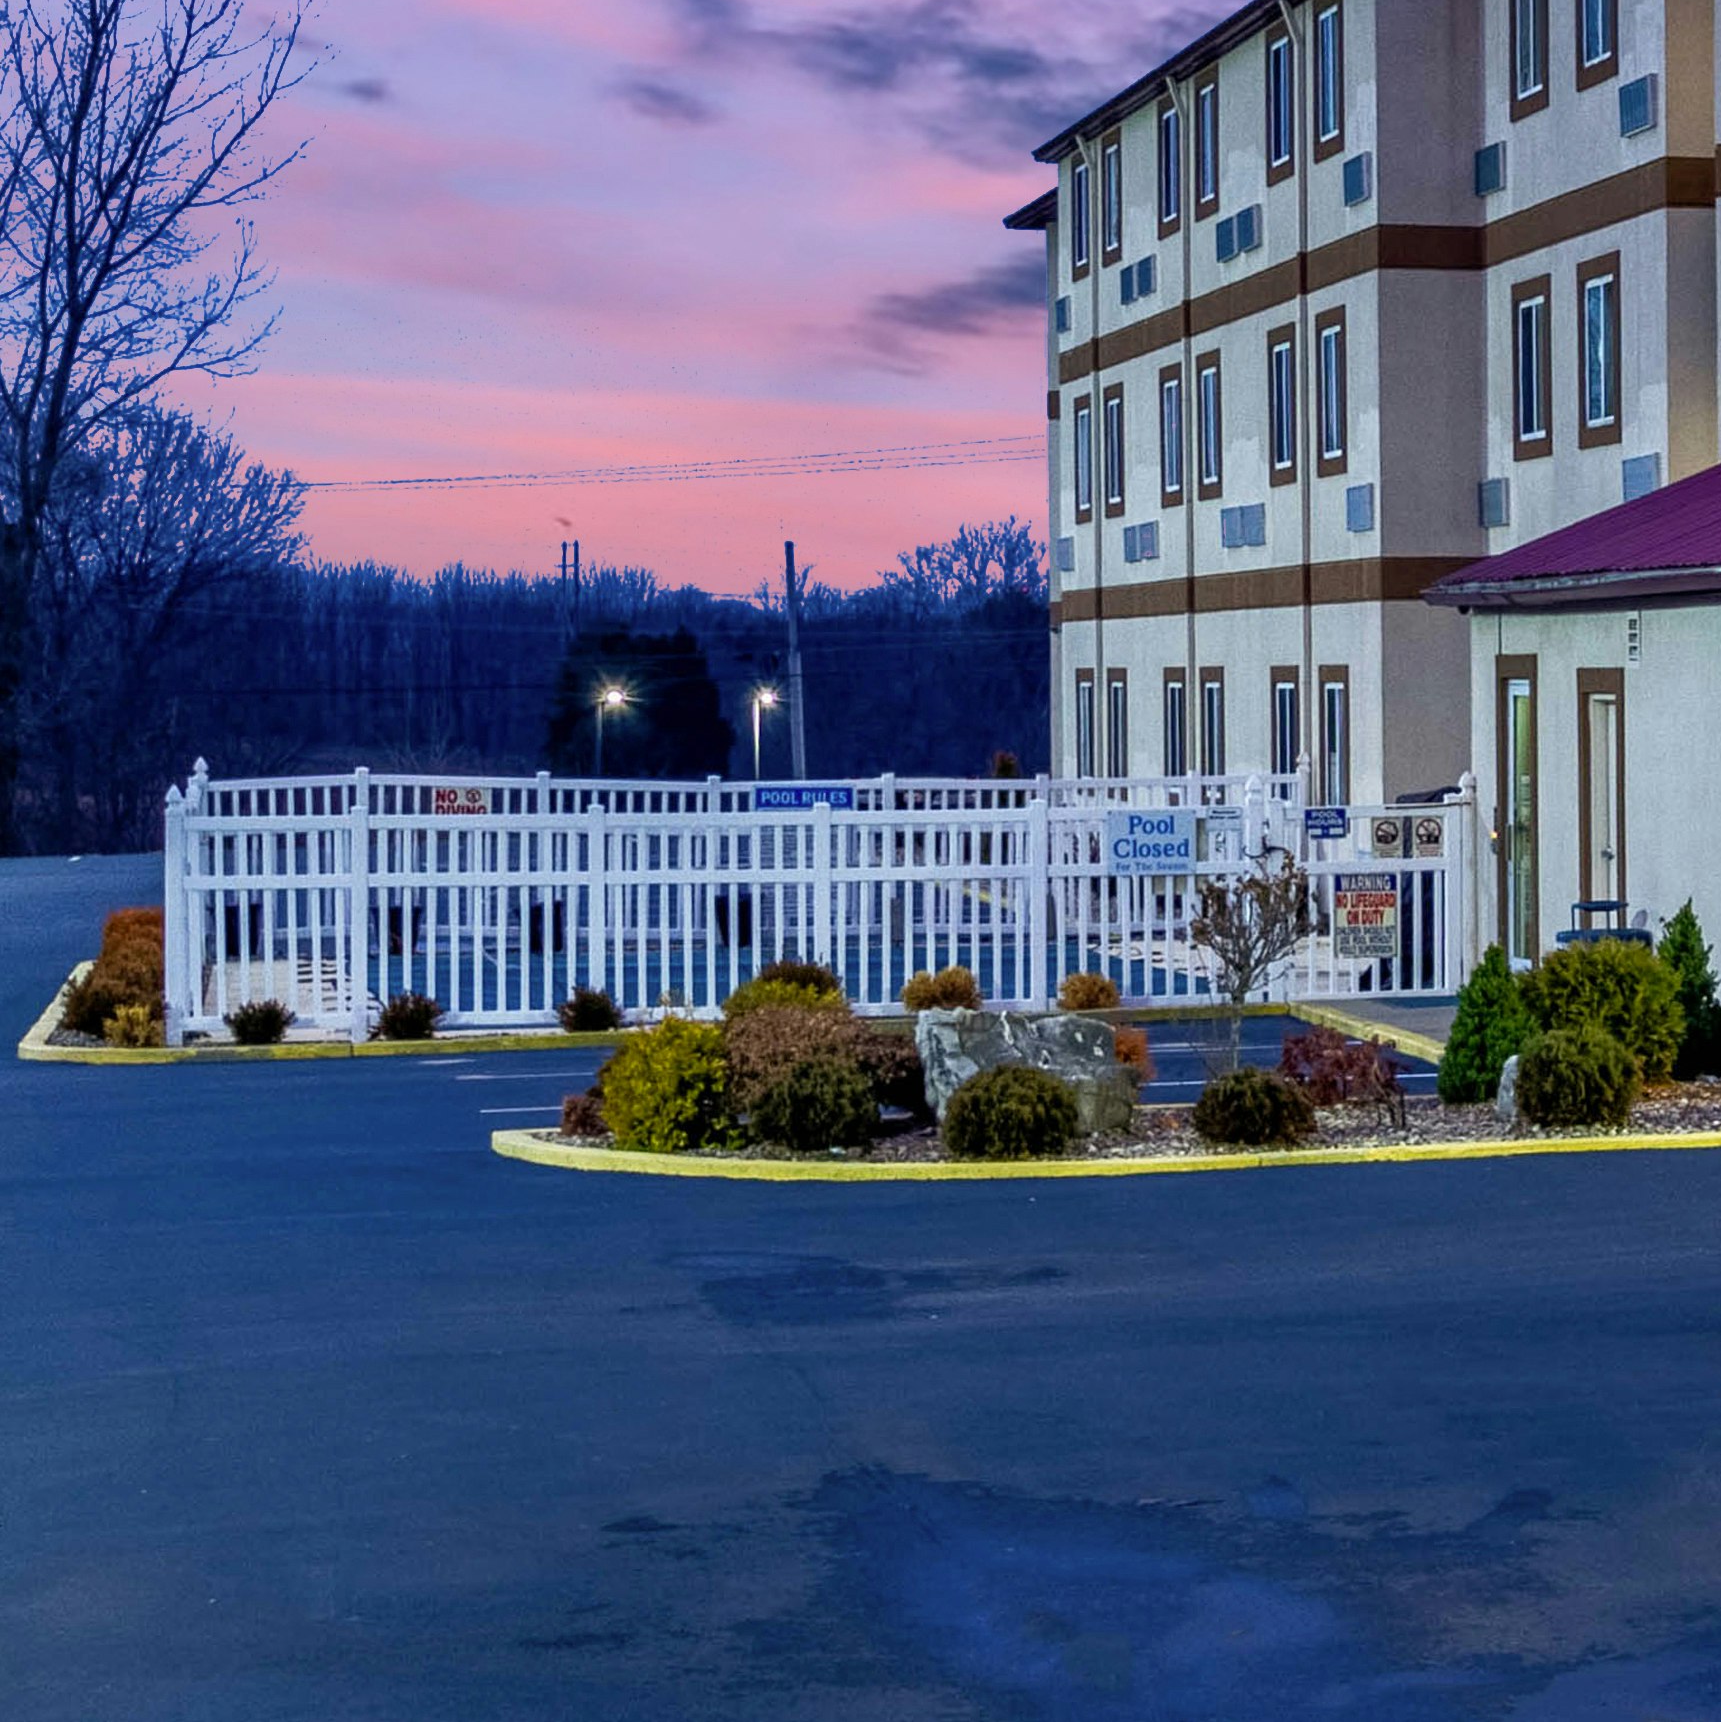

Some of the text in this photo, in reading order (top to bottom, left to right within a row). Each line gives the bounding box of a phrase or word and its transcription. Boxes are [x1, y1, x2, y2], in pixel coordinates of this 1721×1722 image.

[436, 789, 458, 804] NO
[761, 791, 848, 805] POOL RULES
[1129, 815, 1175, 835] Pool
[1113, 838, 1190, 858] Closed
[1341, 875, 1391, 891] WARNING
[1336, 893, 1396, 909] NO LIFEGUARD
[1347, 909, 1384, 925] ON DUTY
